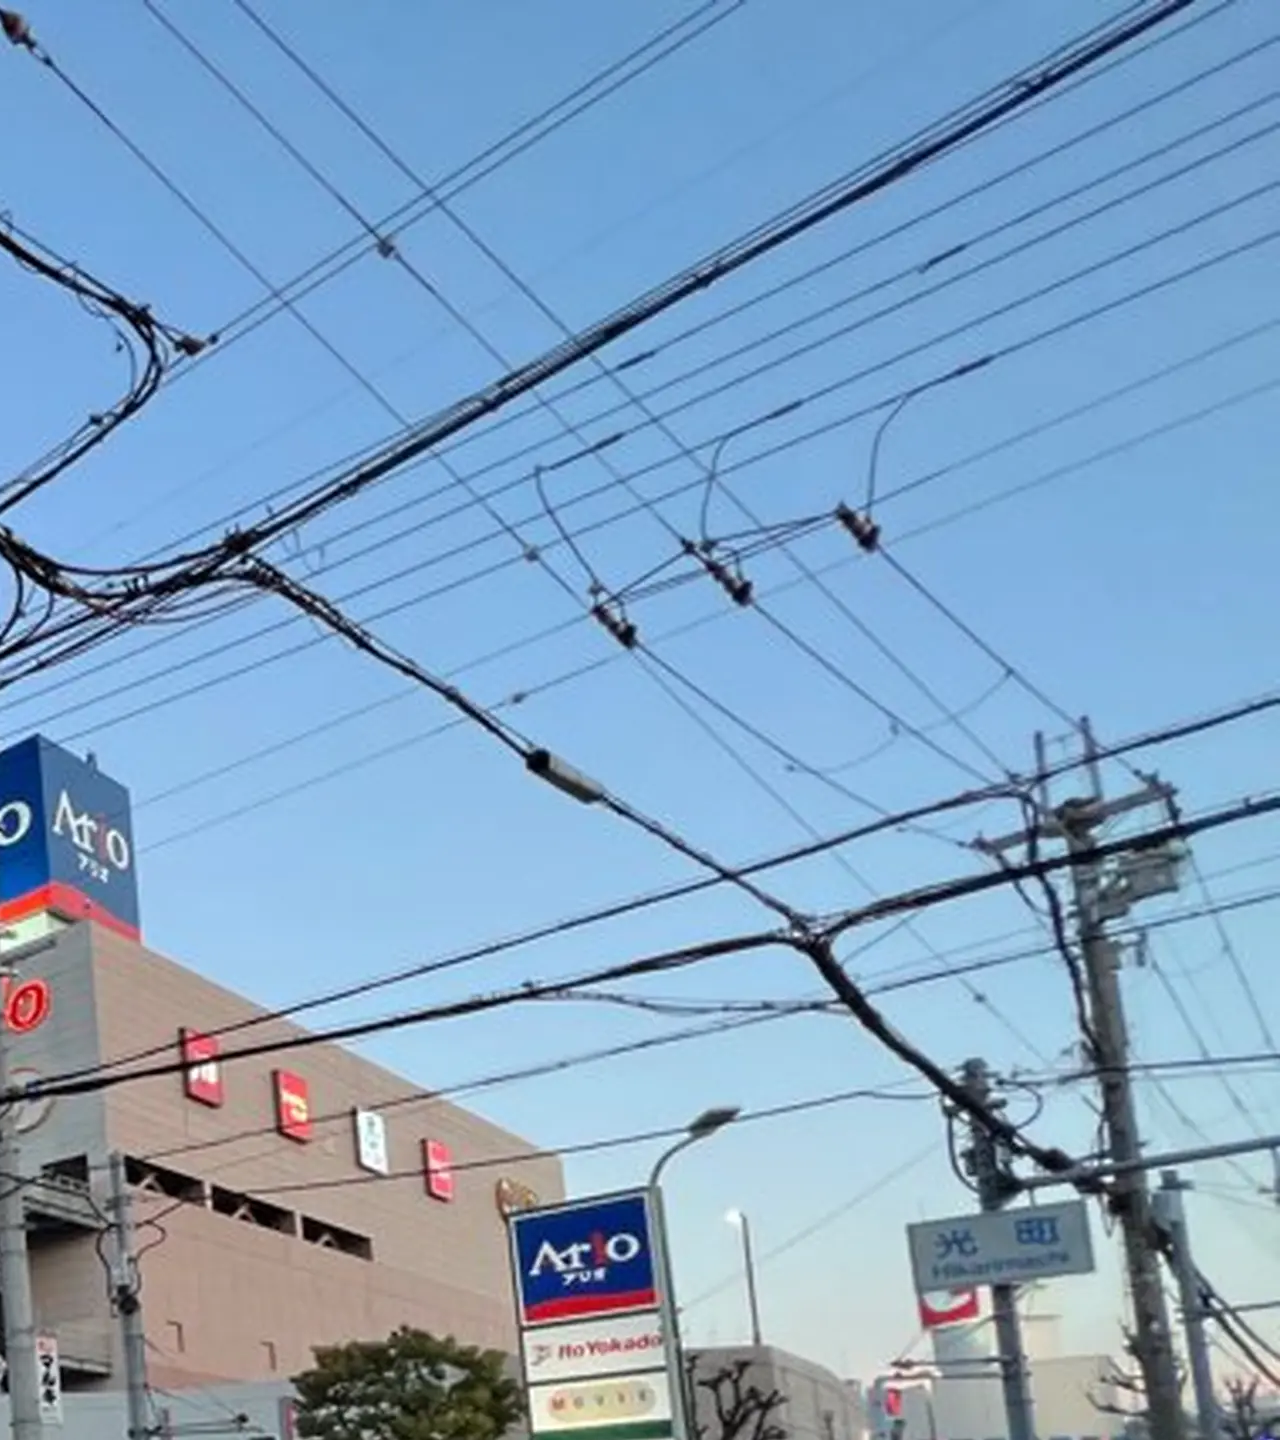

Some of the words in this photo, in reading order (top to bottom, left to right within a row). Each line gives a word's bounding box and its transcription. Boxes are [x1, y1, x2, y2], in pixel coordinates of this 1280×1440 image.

[51, 788, 130, 871] Ario
[528, 1228, 641, 1276] Ario
[933, 1215, 1061, 1258] 光町
[558, 1343, 584, 1359] Ito
[586, 1333, 664, 1356] Yokado
